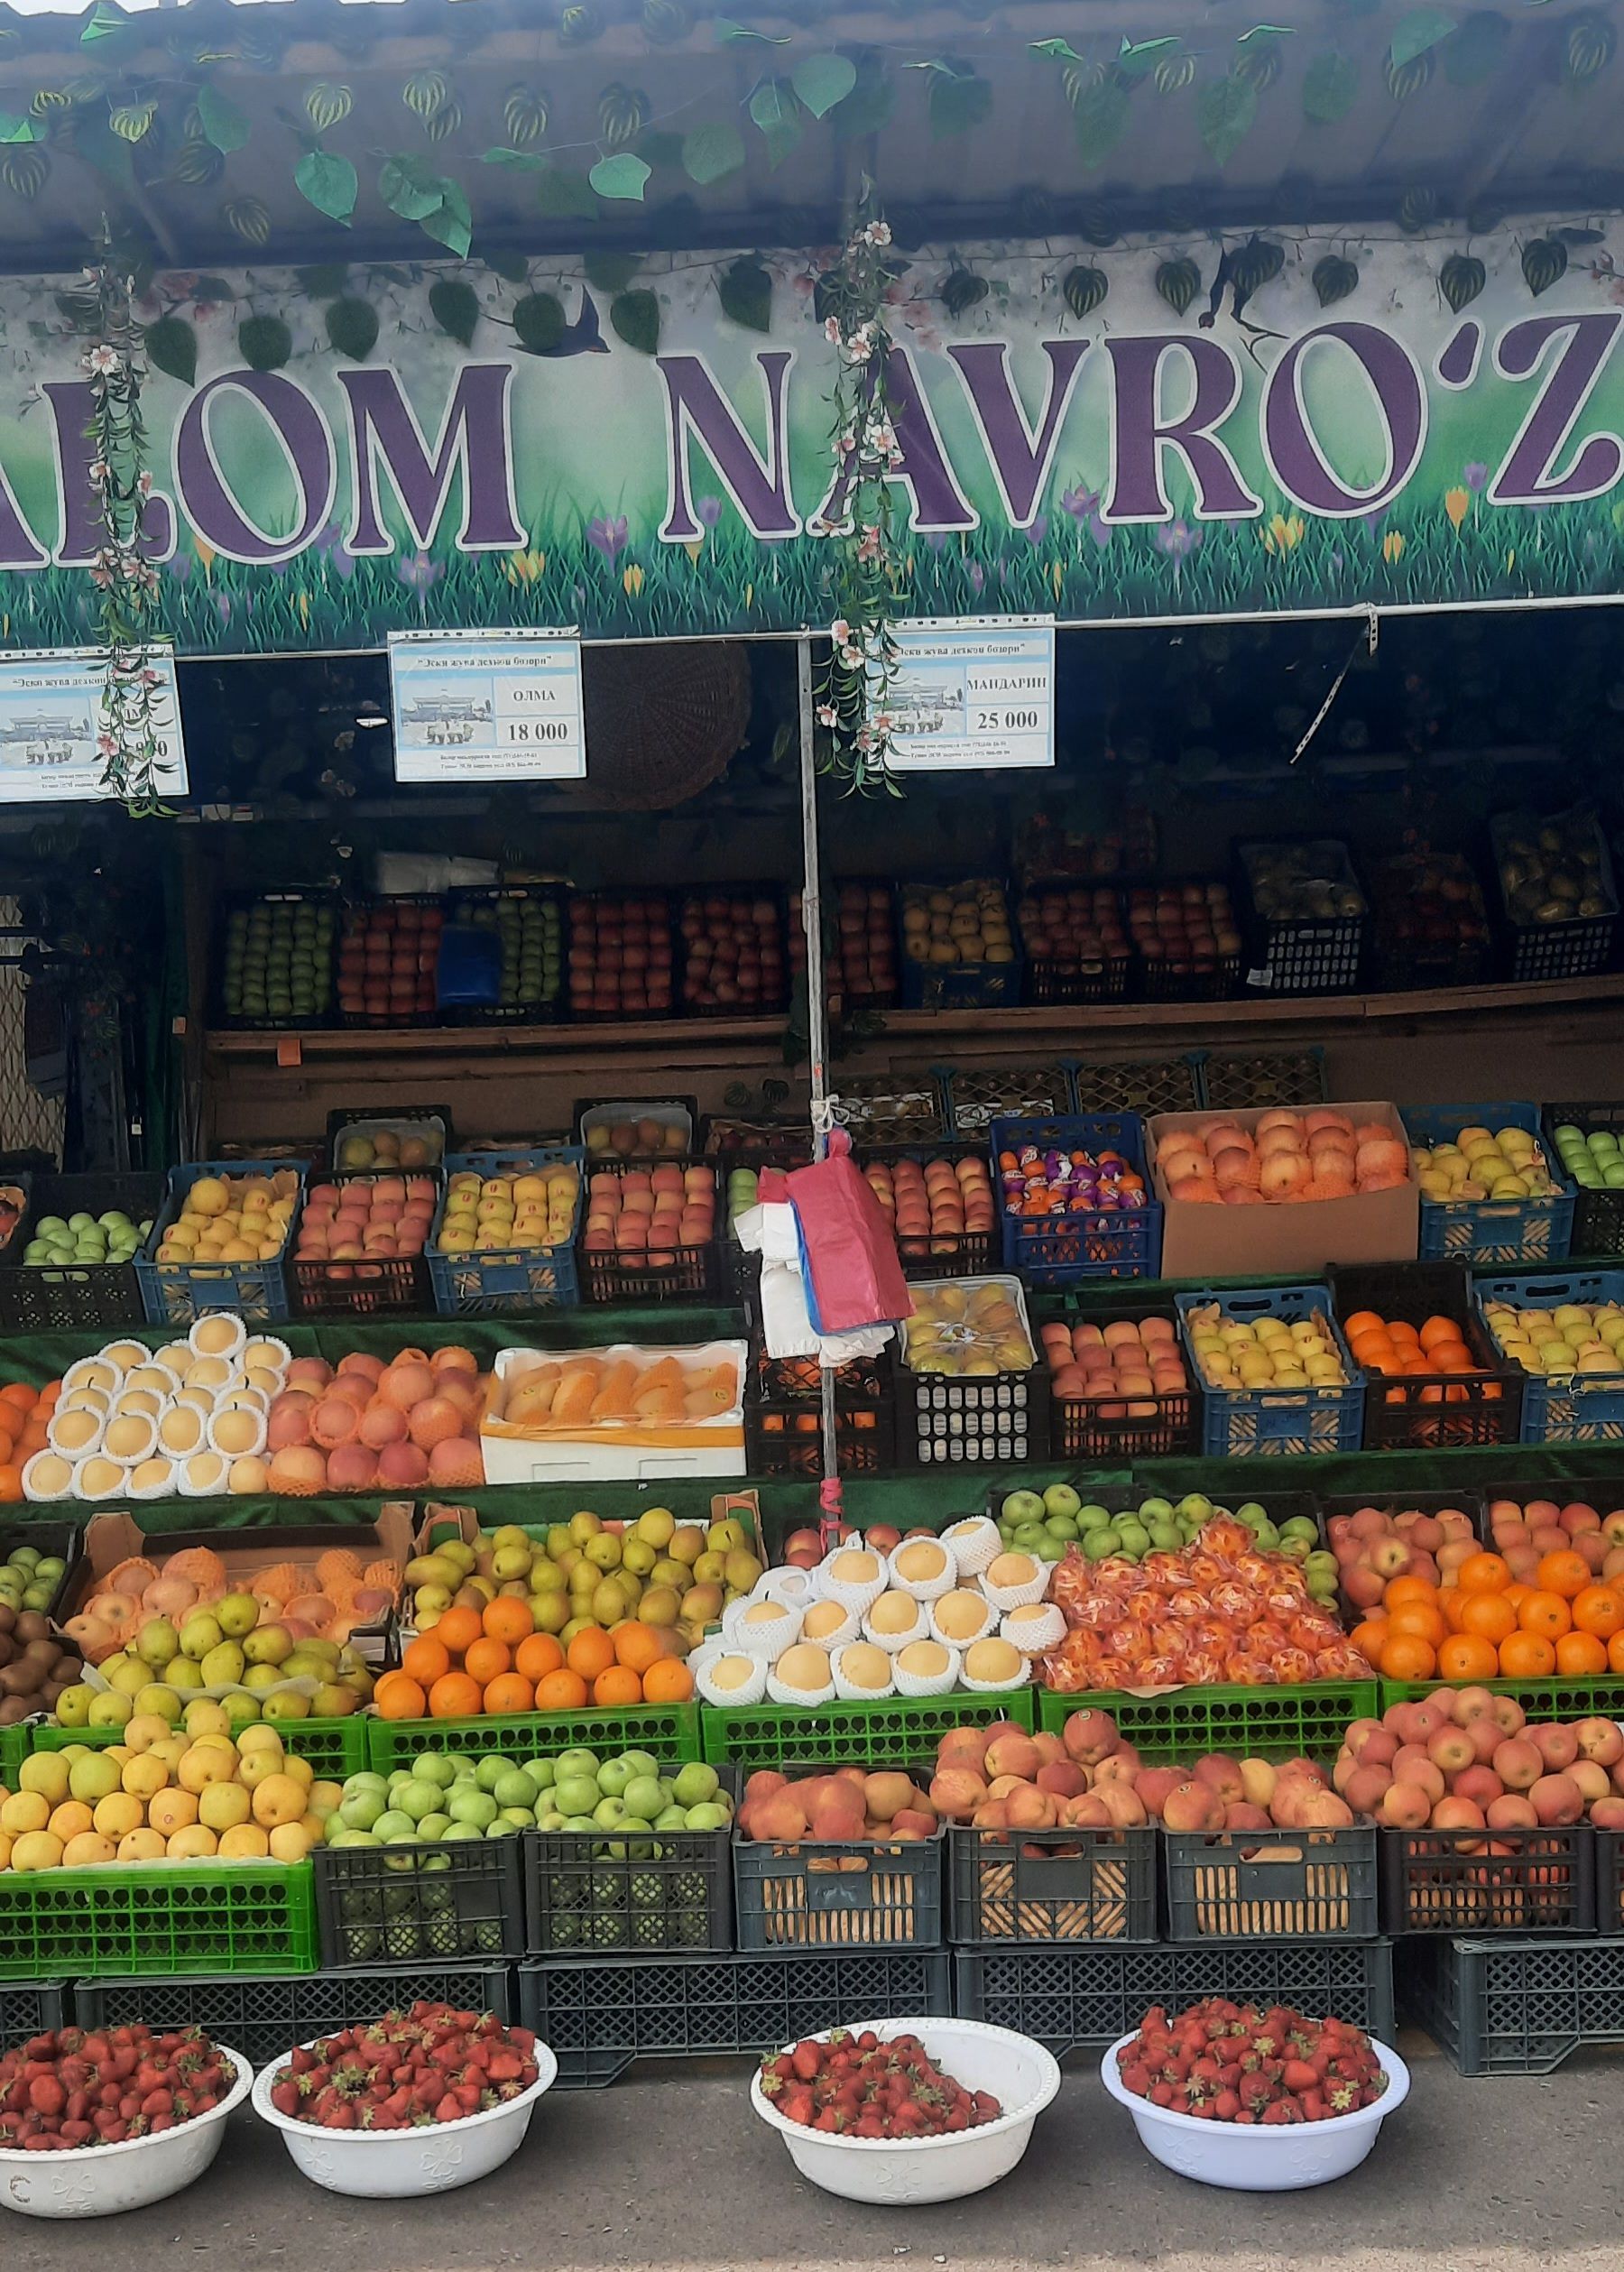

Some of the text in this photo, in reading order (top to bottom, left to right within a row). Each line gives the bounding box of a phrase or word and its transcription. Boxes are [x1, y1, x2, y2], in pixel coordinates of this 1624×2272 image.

[967, 677, 1047, 691] МАНДАРИН
[512, 689, 556, 702] ОЛМА
[977, 710, 1038, 729] 25 000
[508, 722, 568, 741] 18 000
